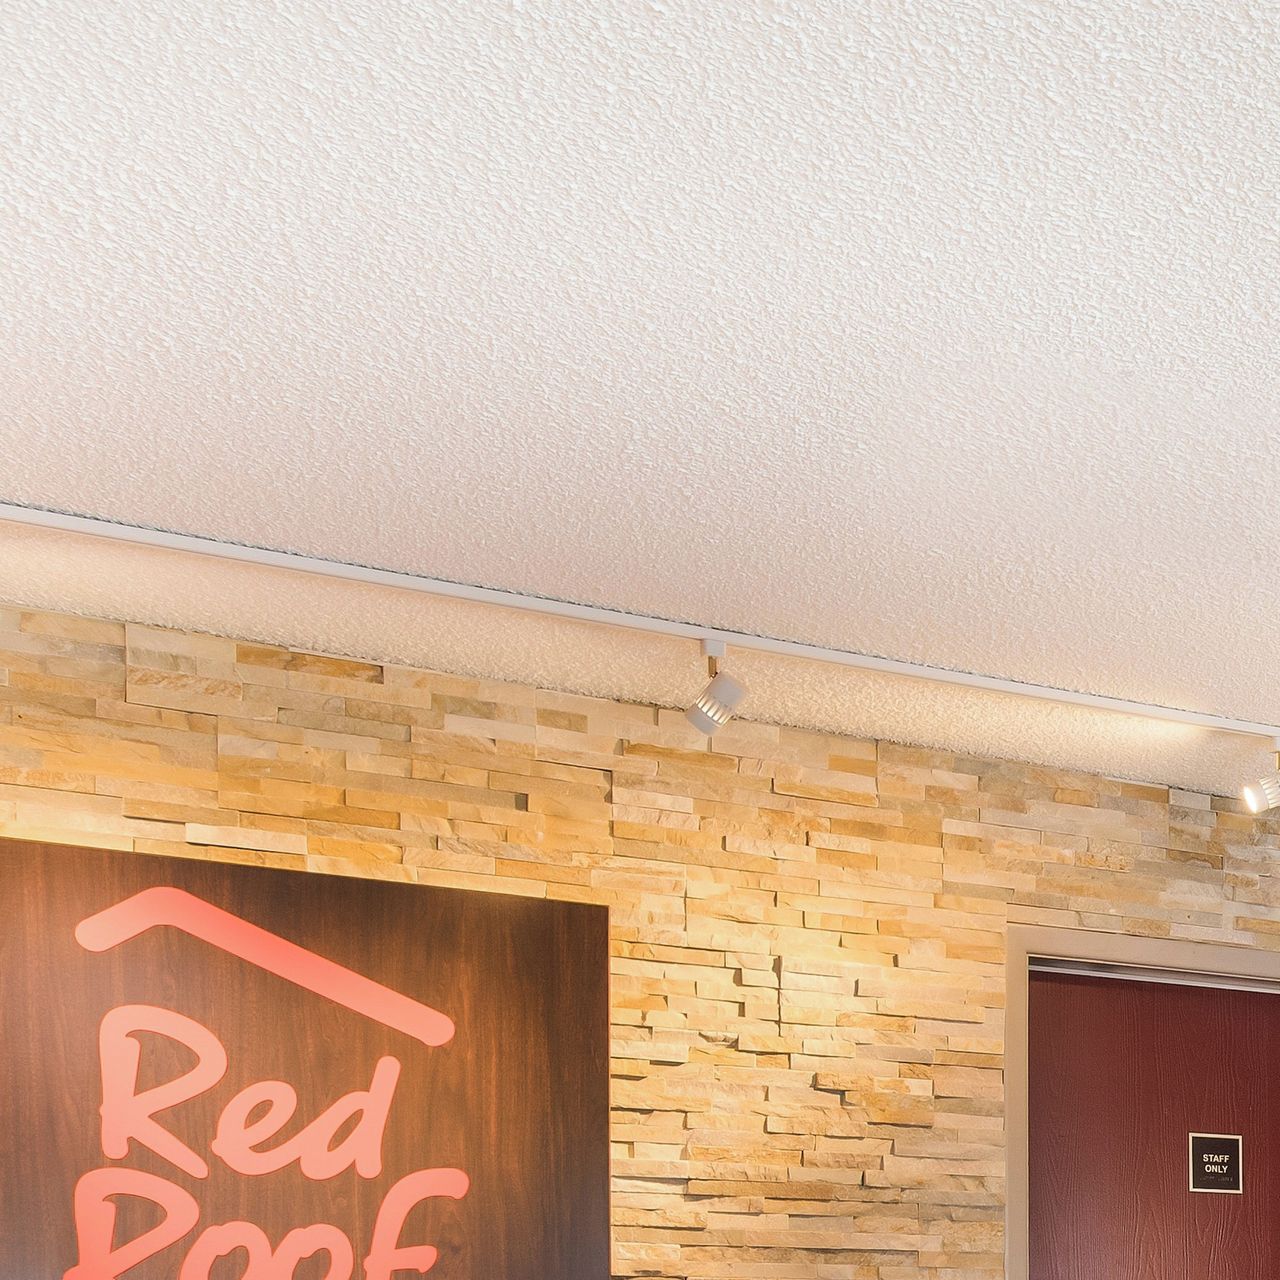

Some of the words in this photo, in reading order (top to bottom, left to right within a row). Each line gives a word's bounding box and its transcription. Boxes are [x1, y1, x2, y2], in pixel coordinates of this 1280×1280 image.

[99, 1004, 401, 1181] Red
[1202, 1153, 1230, 1163] STAFF
[1204, 1164, 1228, 1174] ONLY
